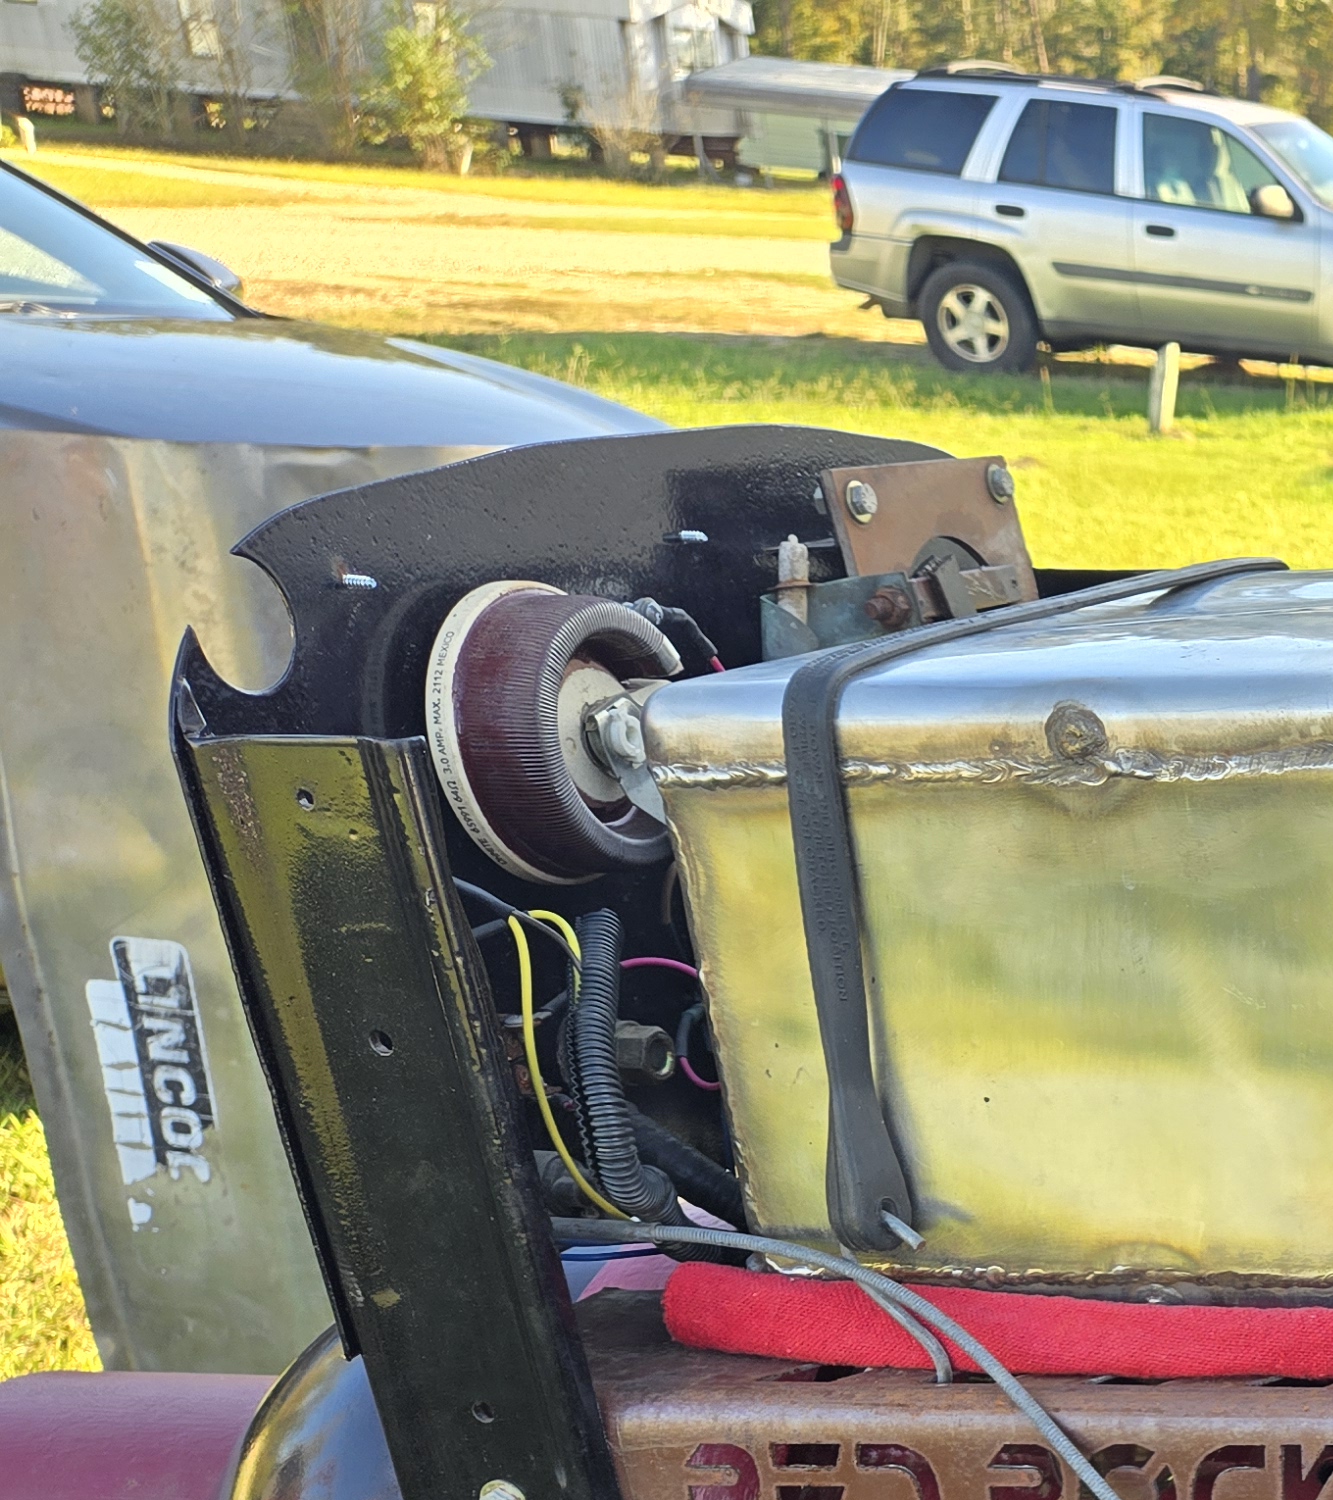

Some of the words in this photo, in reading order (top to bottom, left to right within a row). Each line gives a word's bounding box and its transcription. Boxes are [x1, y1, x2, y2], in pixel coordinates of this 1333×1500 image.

[434, 630, 457, 667] MEXICO
[431, 669, 445, 694] 2112
[431, 697, 443, 725] MAX.
[437, 727, 447, 756] AMP.
[441, 757, 452, 774] 3.0
